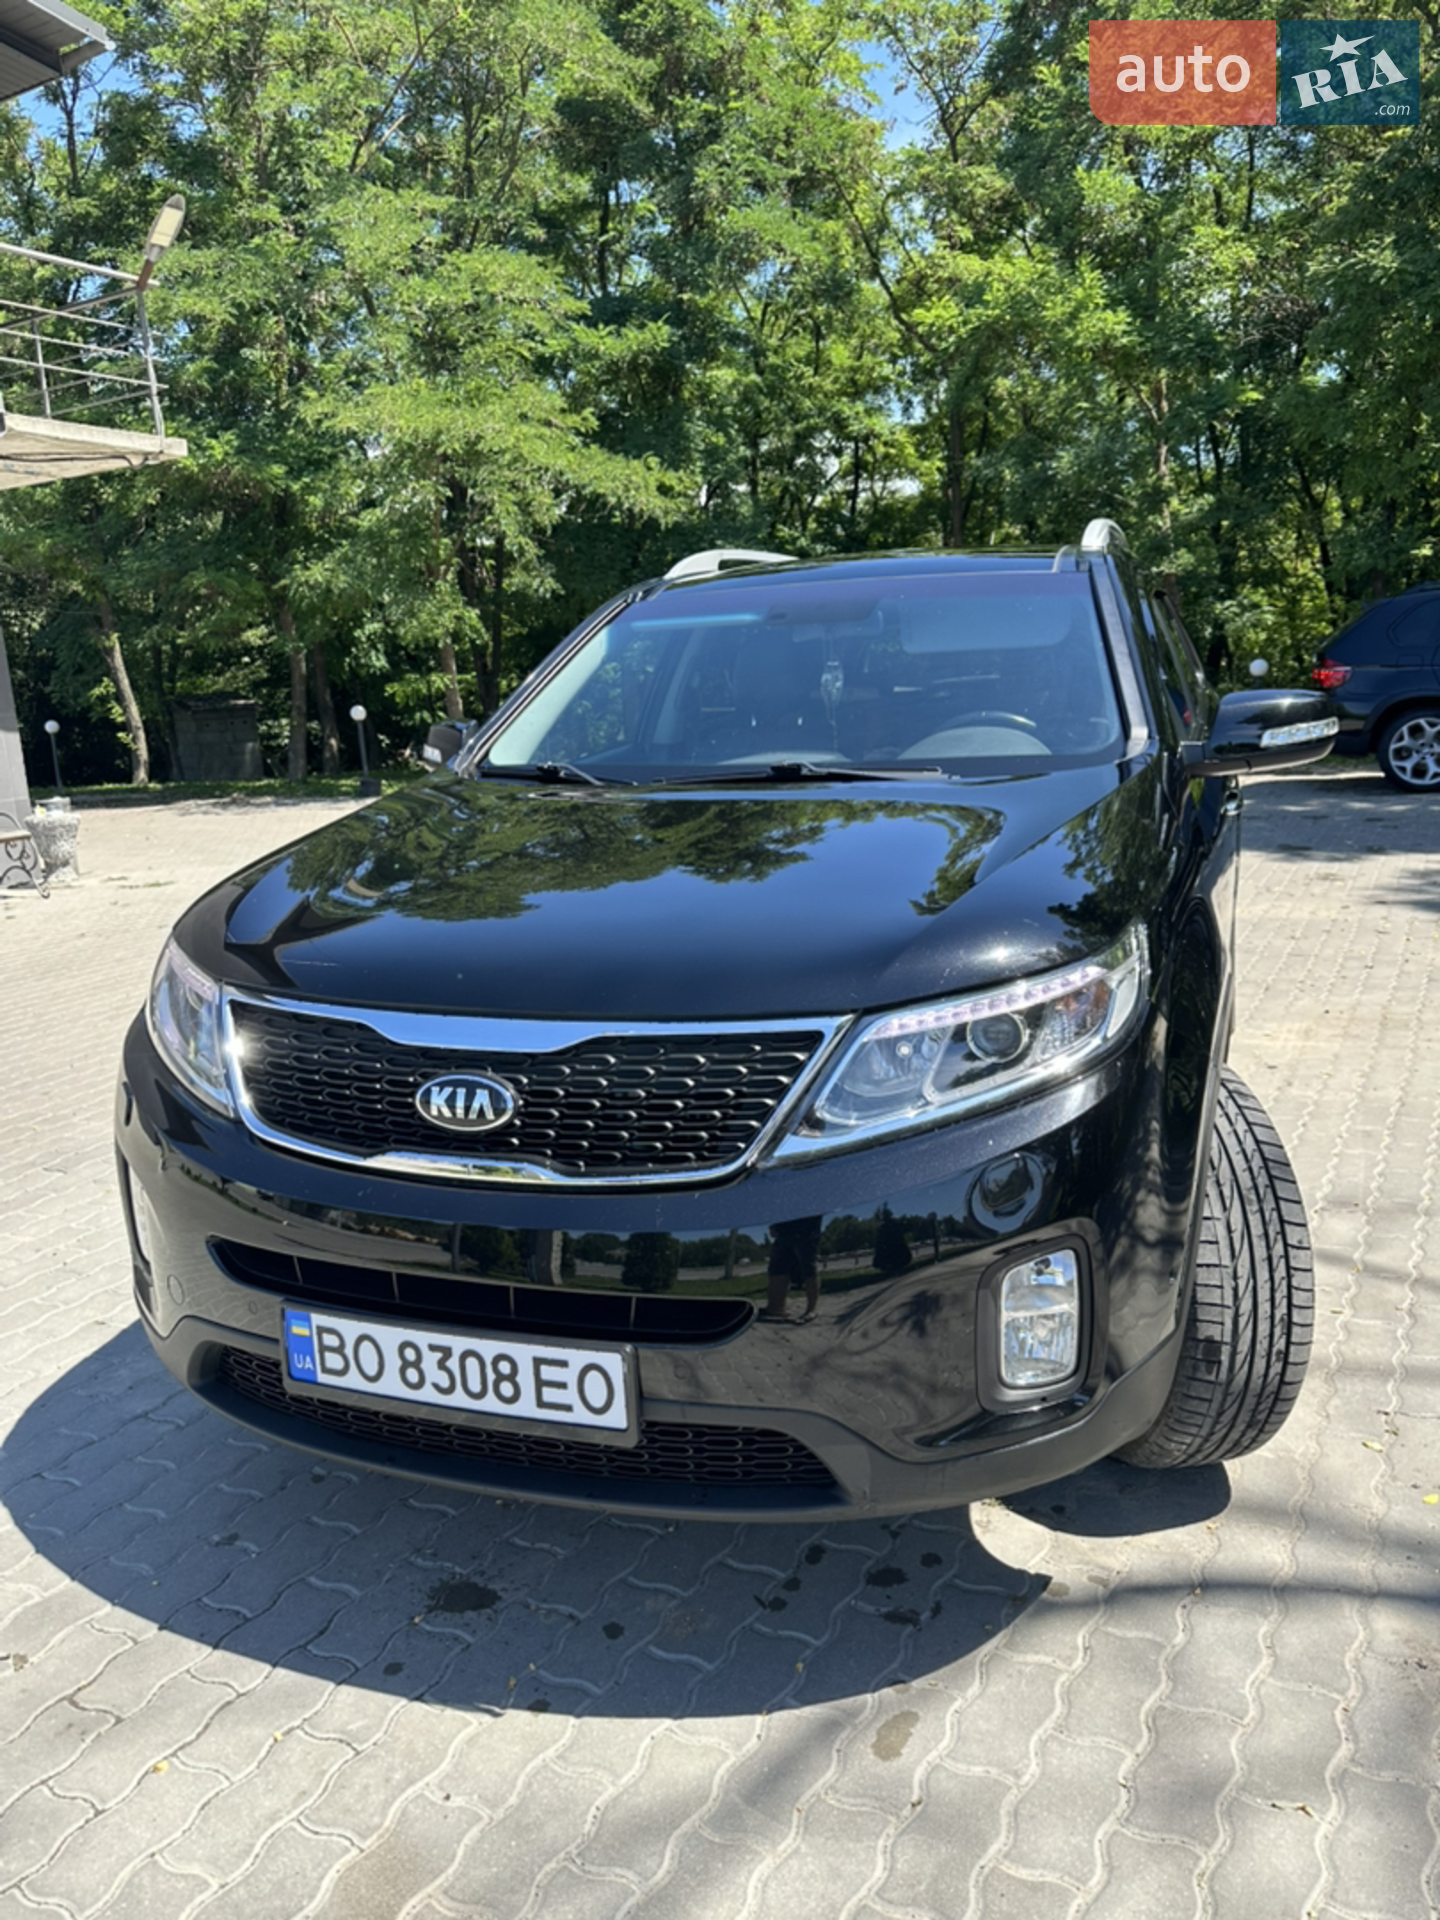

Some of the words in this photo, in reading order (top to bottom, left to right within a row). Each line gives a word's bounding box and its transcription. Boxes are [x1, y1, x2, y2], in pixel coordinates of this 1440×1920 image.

[430, 1086, 495, 1120] KIA
[293, 1352, 315, 1372] UA
[315, 1324, 385, 1384] BO
[397, 1339, 522, 1405] 8308
[532, 1355, 615, 1416] EO
